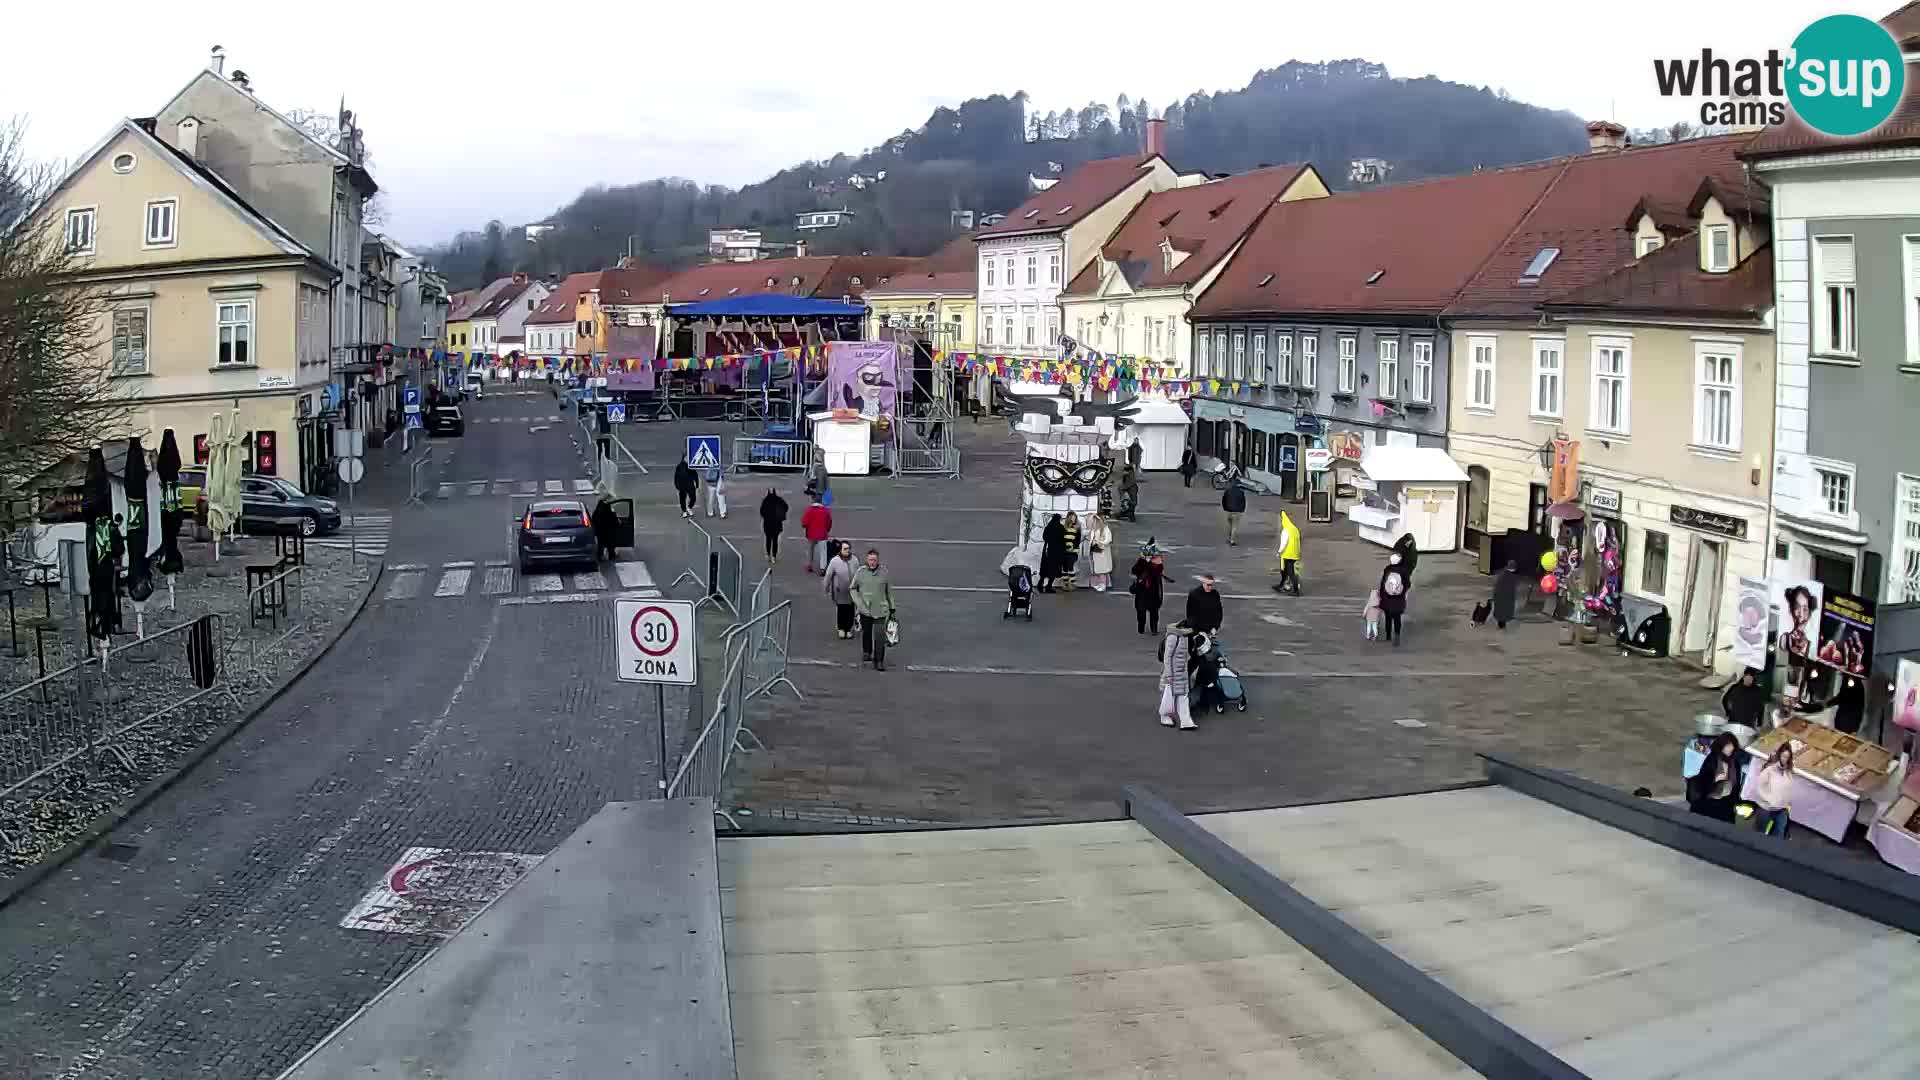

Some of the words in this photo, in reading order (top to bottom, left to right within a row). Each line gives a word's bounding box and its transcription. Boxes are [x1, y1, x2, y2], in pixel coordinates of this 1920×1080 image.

[407, 391, 416, 402] P
[643, 622, 667, 642] 30
[633, 659, 678, 677] ZONA
